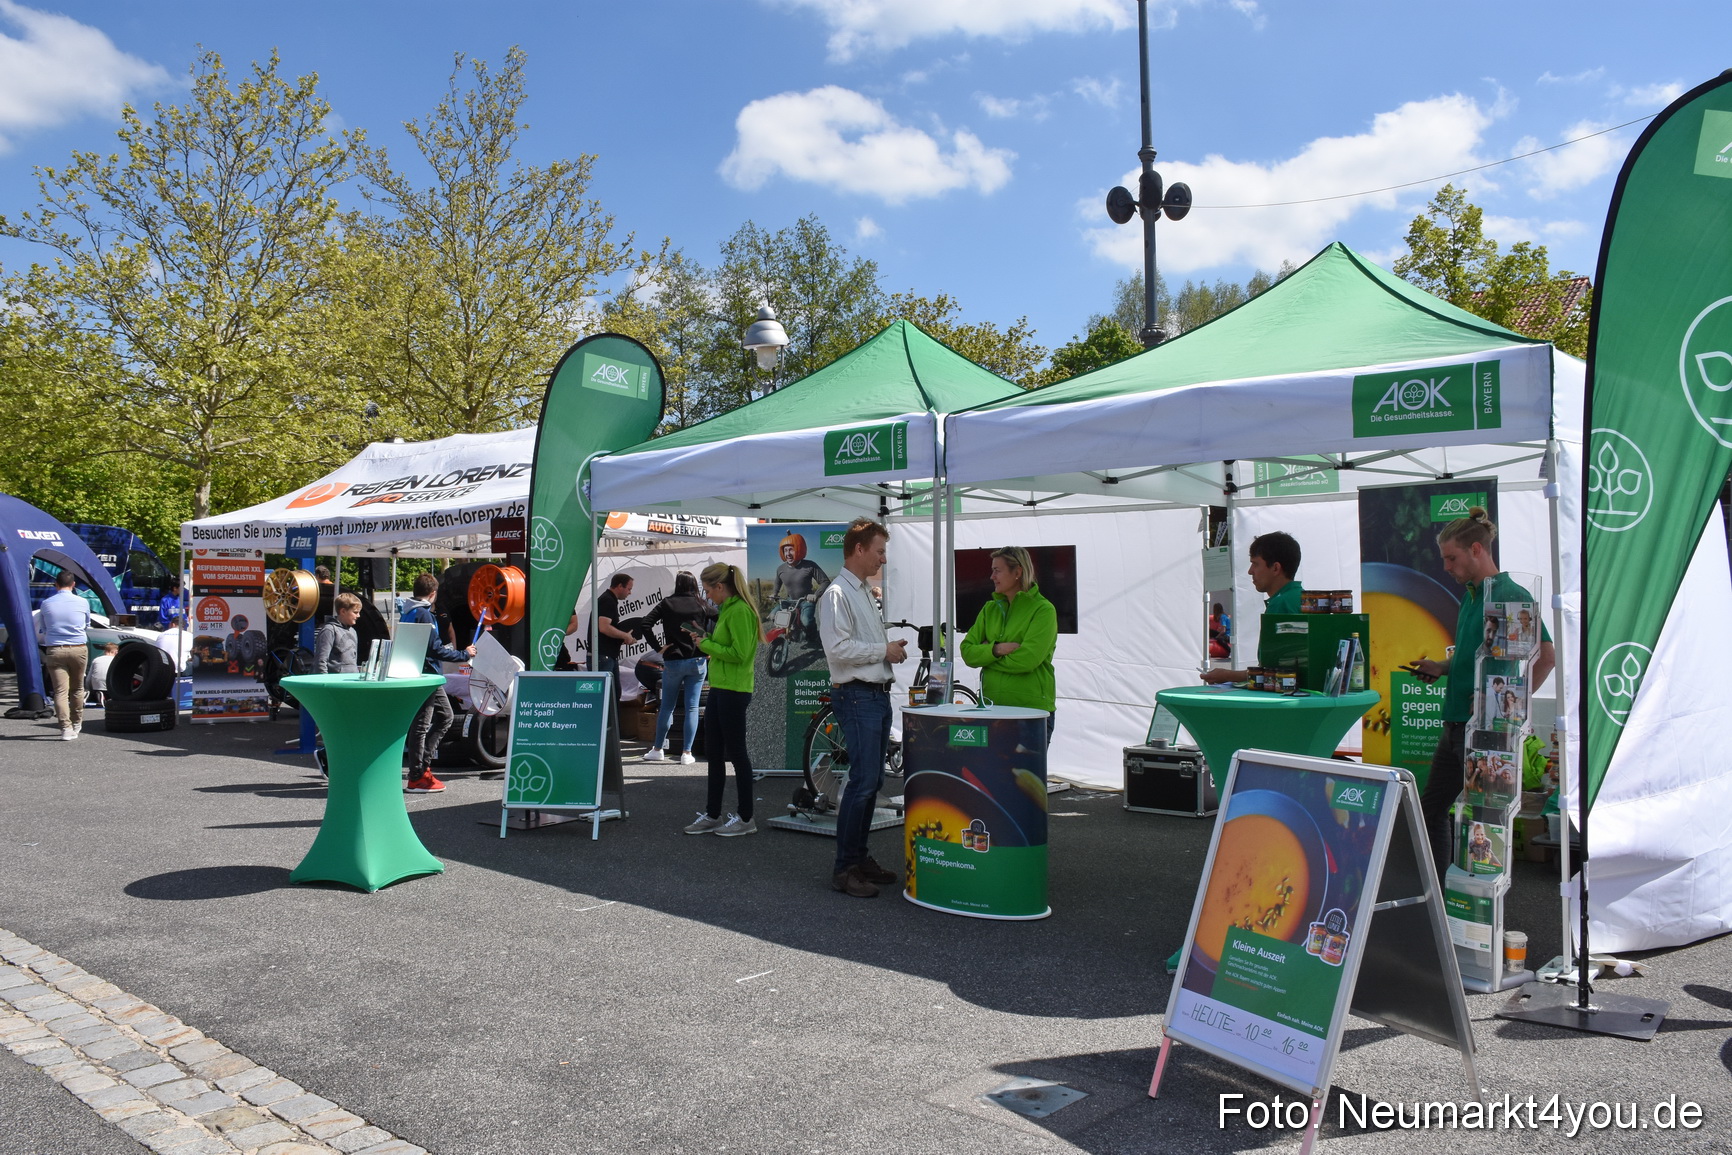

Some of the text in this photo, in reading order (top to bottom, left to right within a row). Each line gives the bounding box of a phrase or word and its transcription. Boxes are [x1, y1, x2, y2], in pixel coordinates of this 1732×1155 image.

[592, 363, 629, 385] AOK
[1372, 376, 1451, 413] AOK
[1483, 371, 1492, 414] BAYERN
[1384, 409, 1455, 422] Gesundheitskasse.
[835, 431, 880, 459] AOK
[842, 456, 882, 465] Gesundheitskasse.
[341, 462, 532, 496] REIFEN LORENZ
[1438, 497, 1469, 512] AOK
[192, 524, 240, 540] Besuchen
[243, 524, 260, 539] Sie
[262, 526, 282, 538] uns
[300, 523, 344, 537] ernet
[347, 521, 379, 535] unter
[381, 502, 525, 532] www.reifen-lorenz.de
[17, 529, 61, 541] FALKEN
[495, 530, 523, 539] ALUTEC
[196, 564, 250, 572] REIFENREPARATUR
[217, 573, 257, 581] SPEZIALISTEN
[618, 587, 663, 617] eifen- und
[204, 607, 223, 615] 80%
[794, 679, 826, 688] Vollspaß
[1401, 683, 1447, 699] Die Sup
[520, 701, 533, 709] Wir
[535, 701, 571, 709] wünschen
[1402, 701, 1441, 714] gegen
[533, 709, 554, 718] Spaß!
[552, 722, 577, 730] Bayern
[954, 729, 975, 740] AOK
[1338, 787, 1366, 803] AOK
[919, 844, 945, 857] Die Suppe
[919, 855, 977, 870] gegen Suppenkoma.
[1232, 939, 1286, 964] Kleine Auszeit
[1191, 1002, 1236, 1032] HEUTE
[1276, 1011, 1325, 1033] Einfach nah. Meine AOK.
